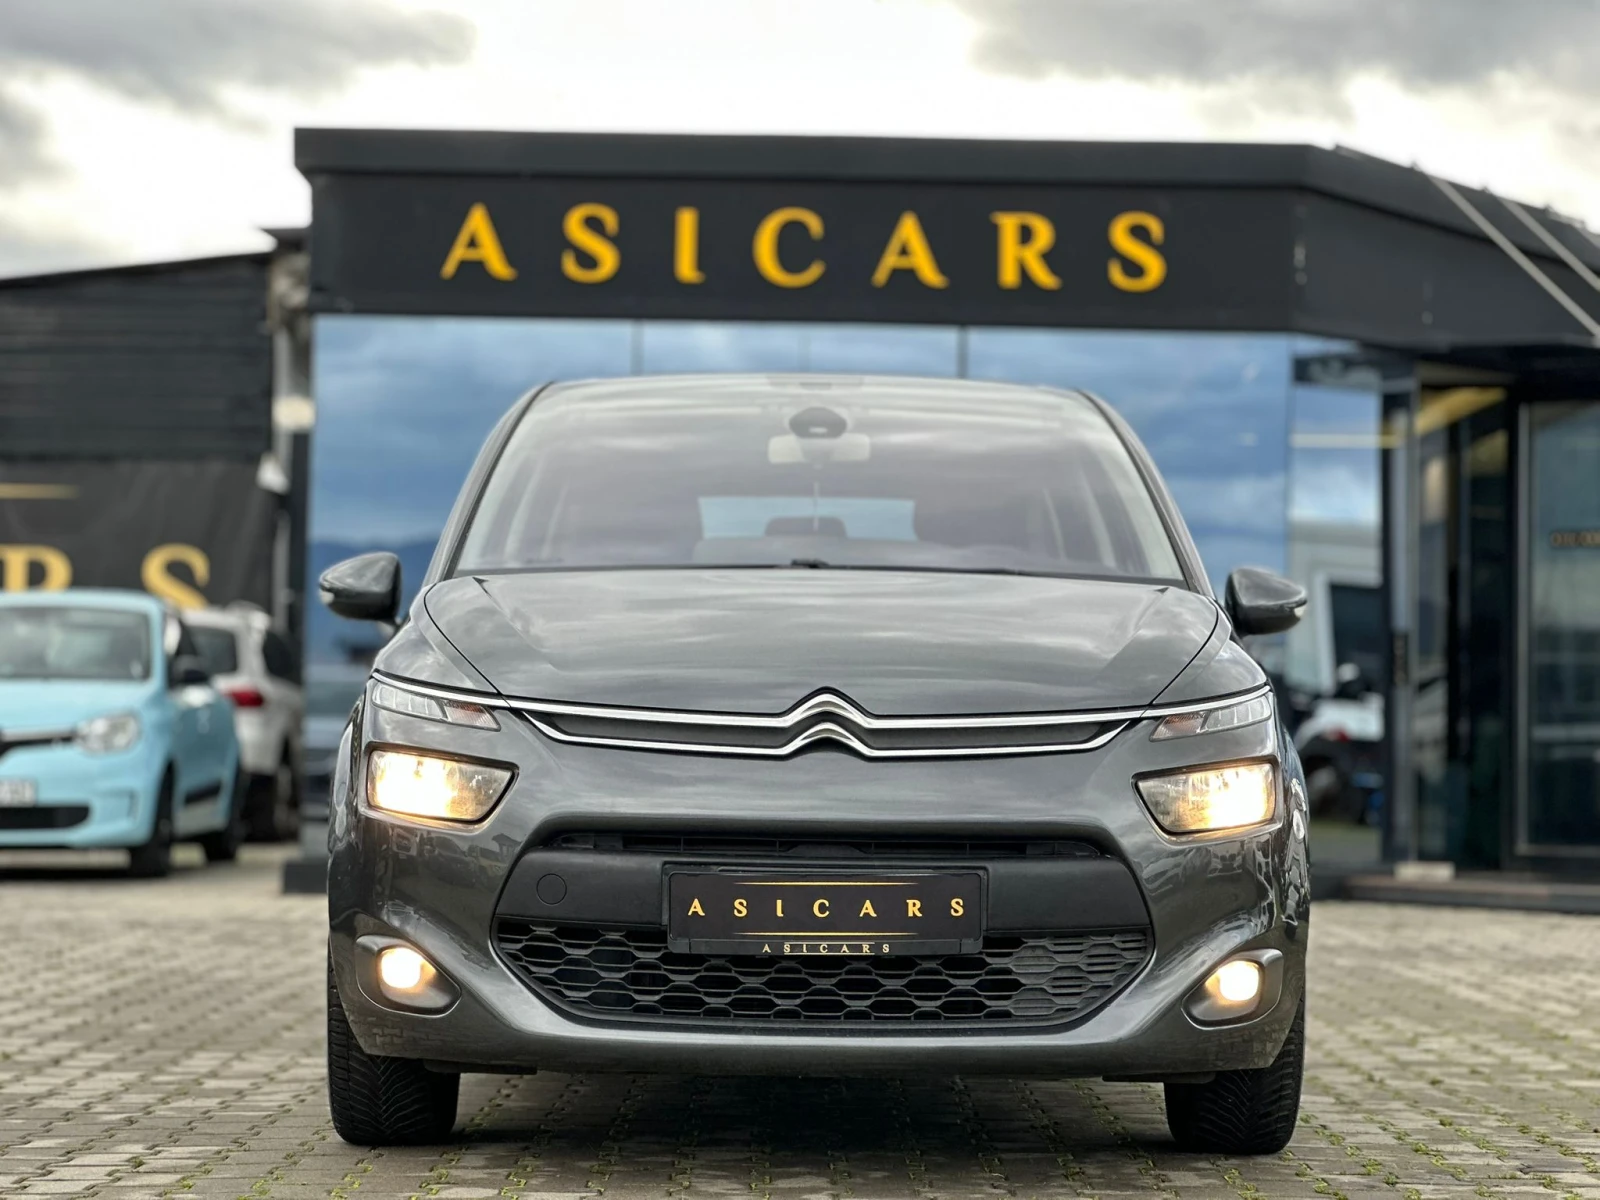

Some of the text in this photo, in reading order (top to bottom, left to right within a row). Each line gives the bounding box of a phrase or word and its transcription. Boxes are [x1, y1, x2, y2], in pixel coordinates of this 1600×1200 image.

[438, 202, 1168, 293] ASICARS
[687, 898, 965, 918] ASICARS
[762, 942, 890, 955] ASICARS
